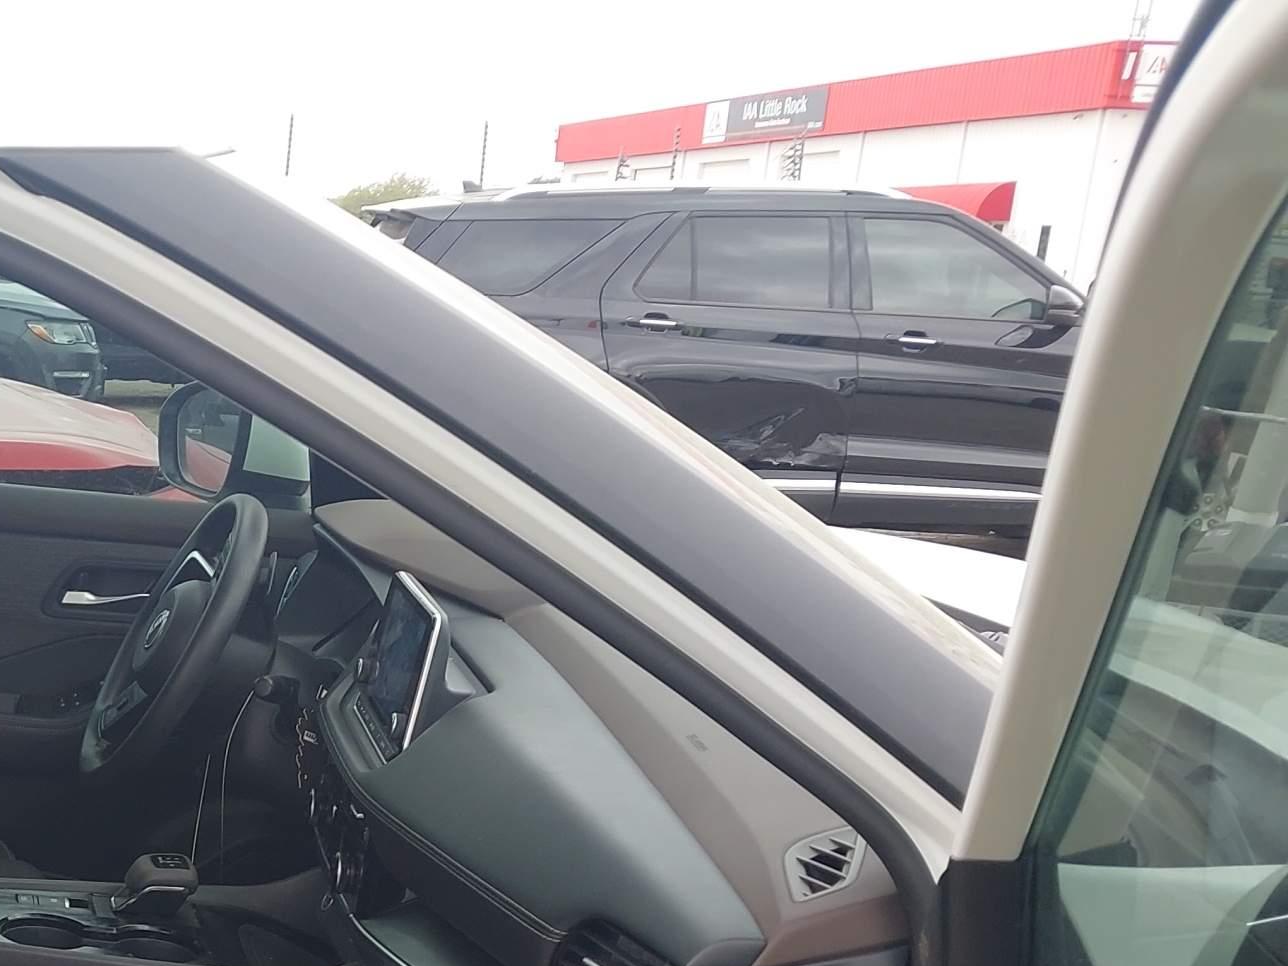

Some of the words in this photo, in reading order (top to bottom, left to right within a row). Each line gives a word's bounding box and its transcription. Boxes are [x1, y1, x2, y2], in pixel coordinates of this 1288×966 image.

[742, 101, 758, 121] IAA
[759, 98, 782, 119] Little
[783, 94, 809, 116] Rock
